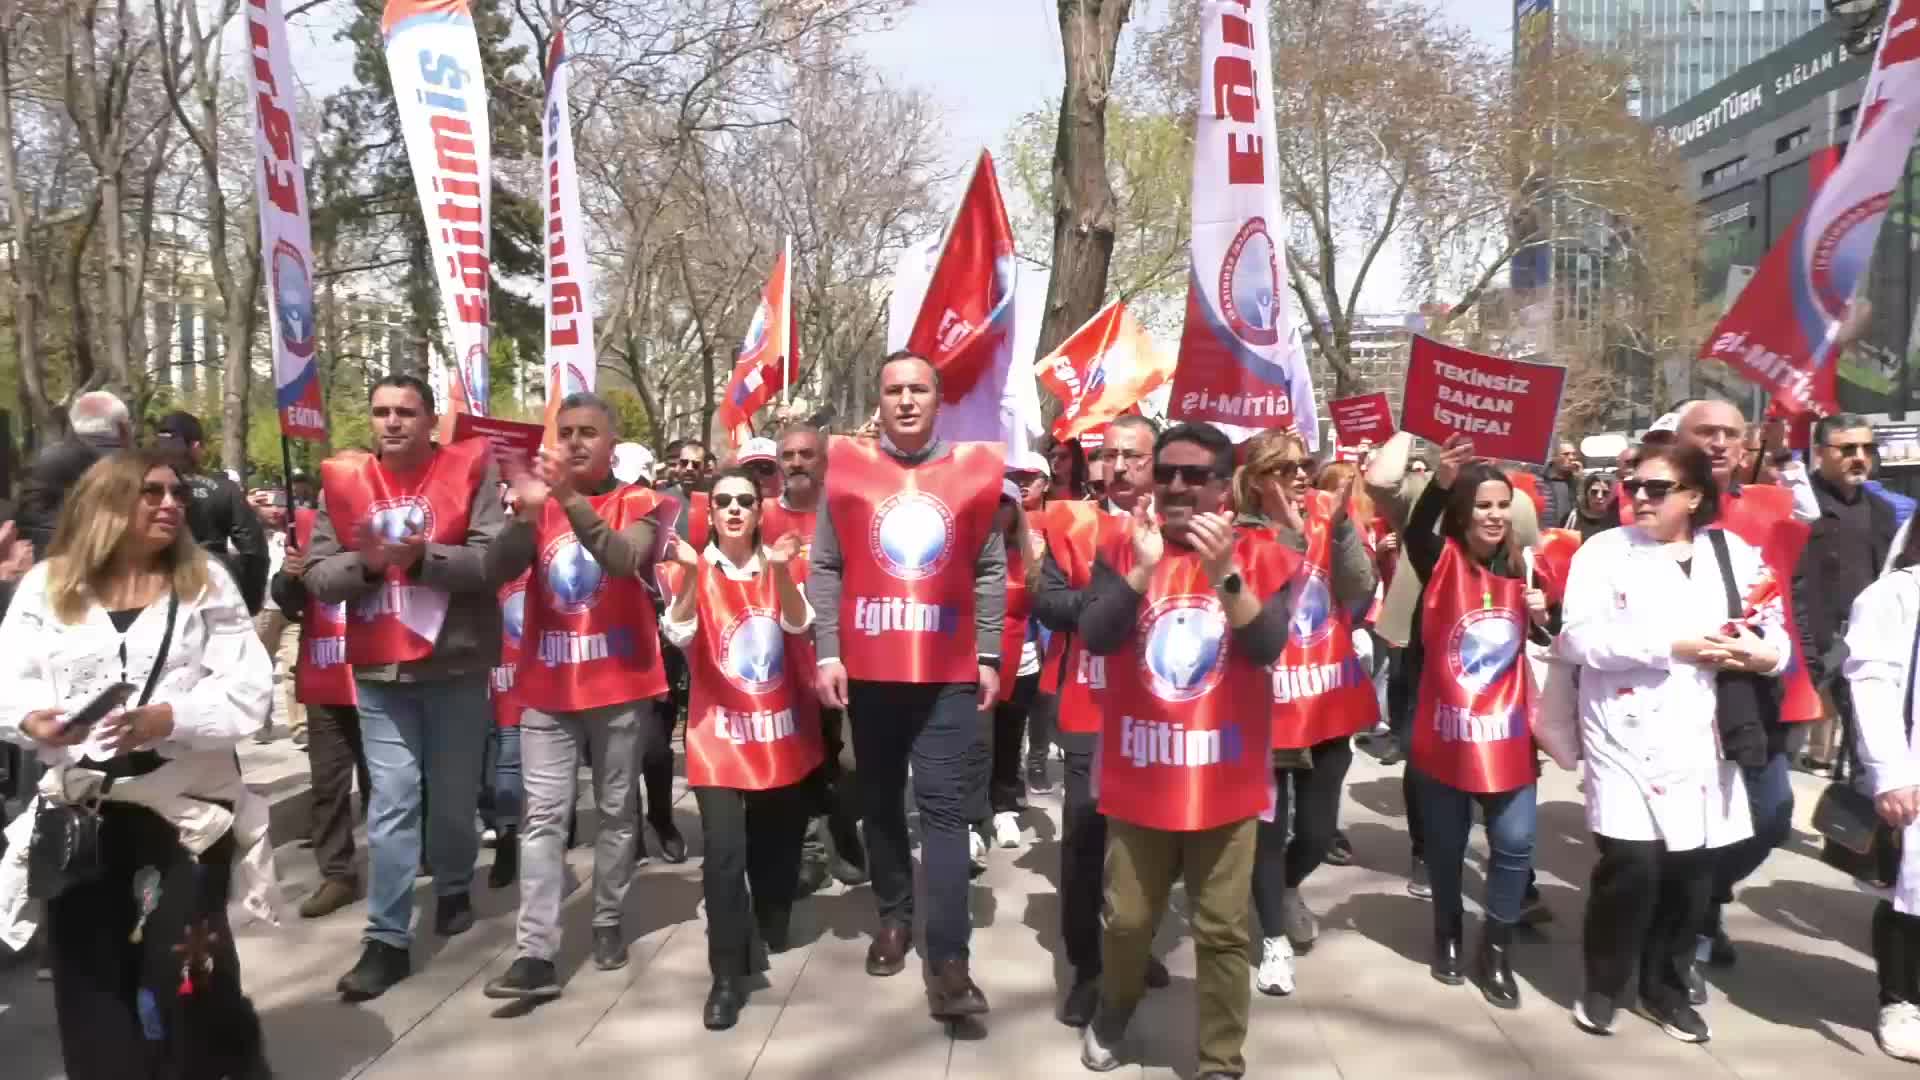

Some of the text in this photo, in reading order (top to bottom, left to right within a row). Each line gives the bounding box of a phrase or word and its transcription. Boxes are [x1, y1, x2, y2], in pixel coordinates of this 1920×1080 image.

[1774, 51, 1833, 95] SAĞLAM
[1433, 359, 1531, 394] TEKİNSİZ
[1438, 384, 1514, 414] BAKAN
[1433, 402, 1512, 437] İSTİFA!
[855, 595, 958, 638] Eğitim
[1120, 714, 1243, 768] Eğitim
